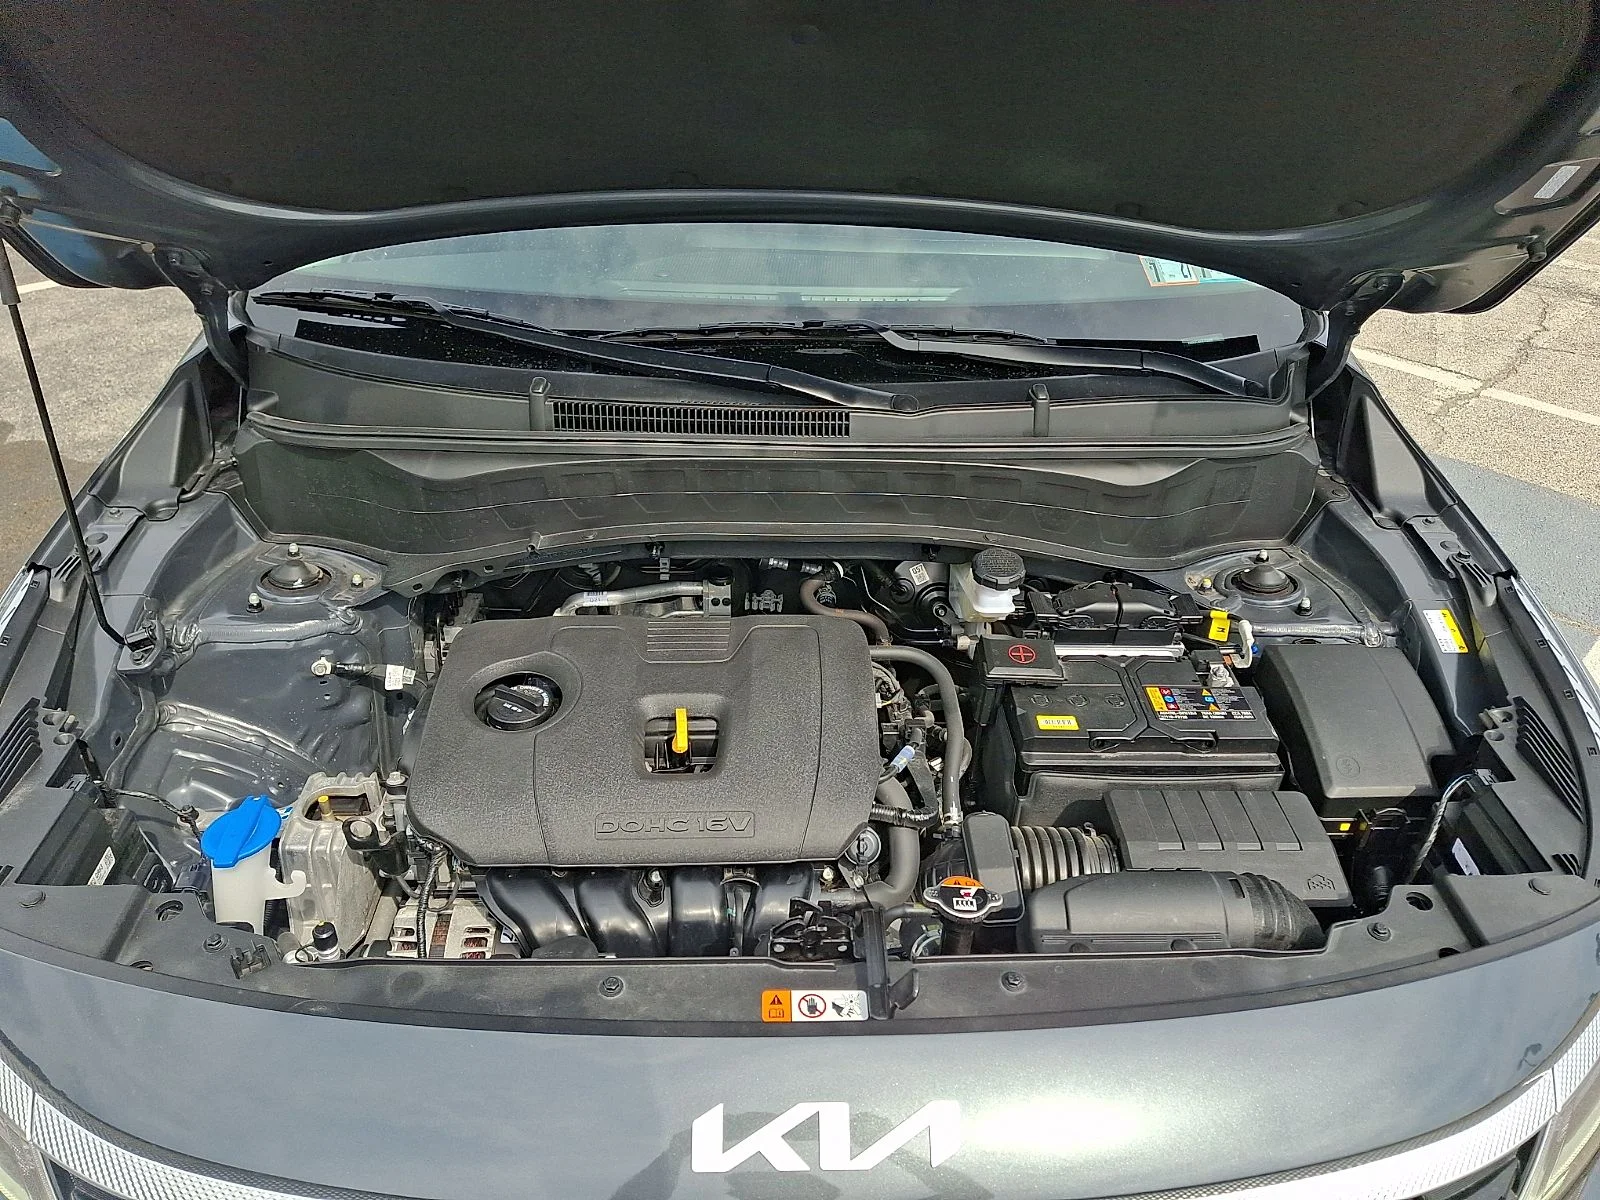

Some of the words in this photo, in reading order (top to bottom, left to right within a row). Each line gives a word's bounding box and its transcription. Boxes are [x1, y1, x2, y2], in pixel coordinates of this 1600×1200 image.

[597, 817, 690, 834] DOHC
[697, 816, 752, 833] 16V
[691, 1100, 961, 1173] KIA
